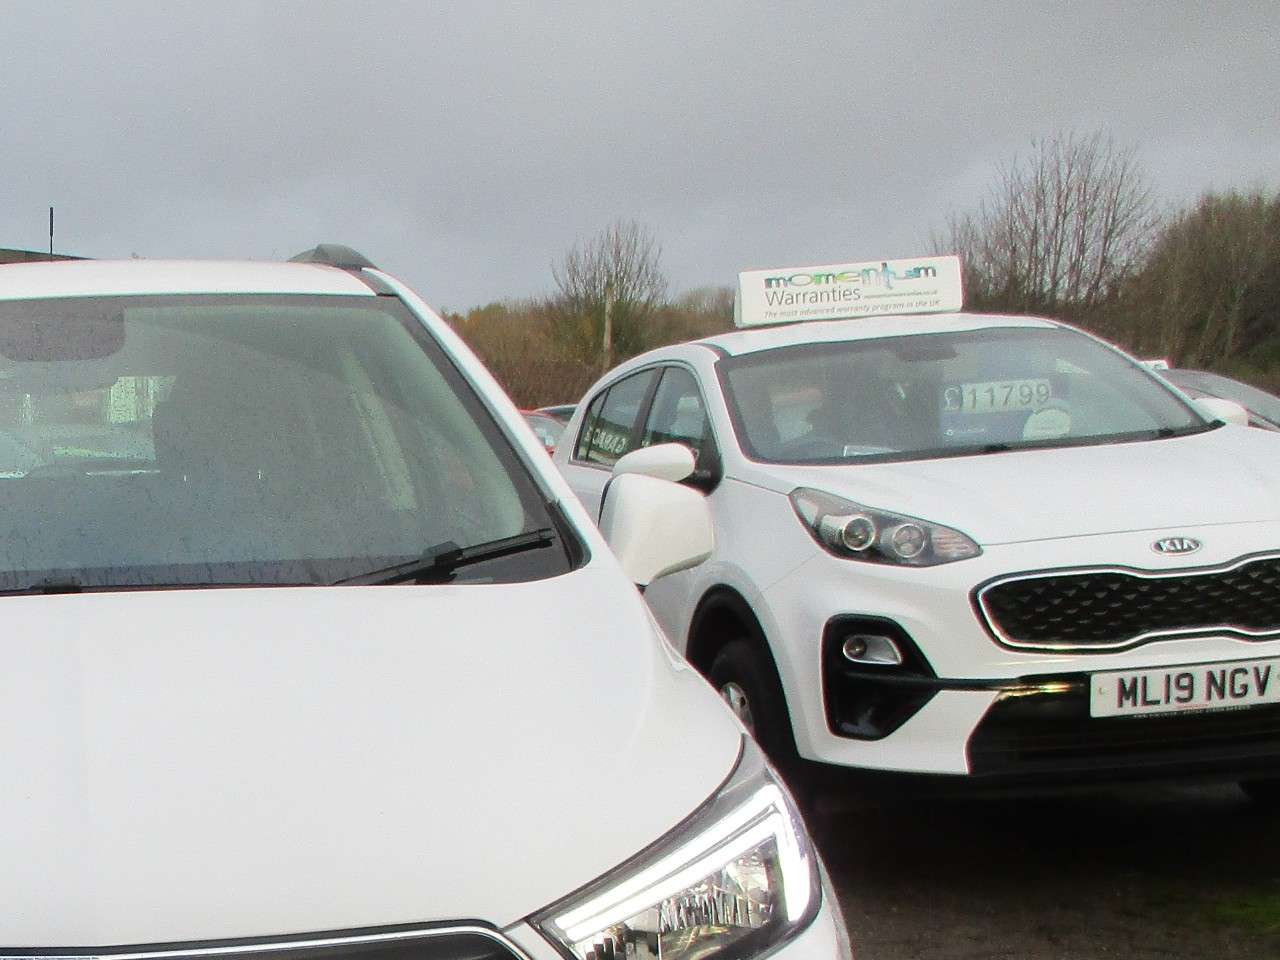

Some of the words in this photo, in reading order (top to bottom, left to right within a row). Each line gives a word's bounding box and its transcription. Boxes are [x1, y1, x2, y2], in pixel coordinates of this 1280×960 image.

[764, 262, 937, 290] momentum
[765, 286, 861, 307] Warranties
[944, 383, 1050, 410] £11799
[1155, 537, 1199, 554] KIA
[1117, 672, 1195, 708] ML19
[1206, 665, 1272, 701] NGV
